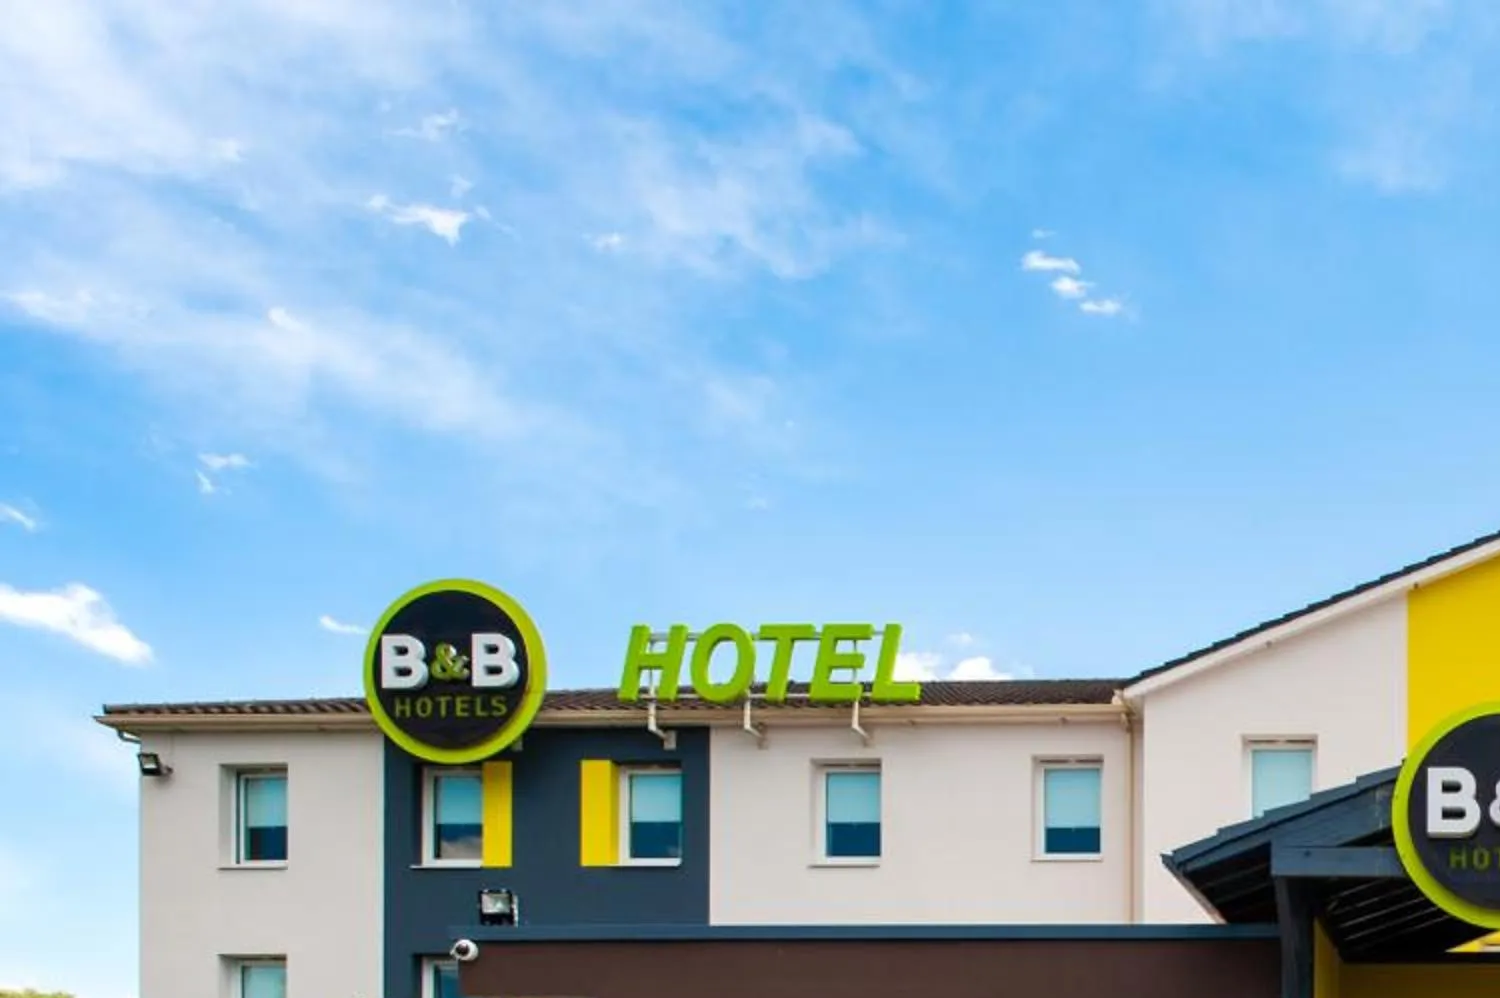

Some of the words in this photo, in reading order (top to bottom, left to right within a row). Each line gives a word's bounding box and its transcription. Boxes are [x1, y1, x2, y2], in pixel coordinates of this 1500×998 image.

[381, 633, 520, 690] B&B
[617, 623, 921, 701] HOTEL
[394, 695, 508, 719] HOTELS
